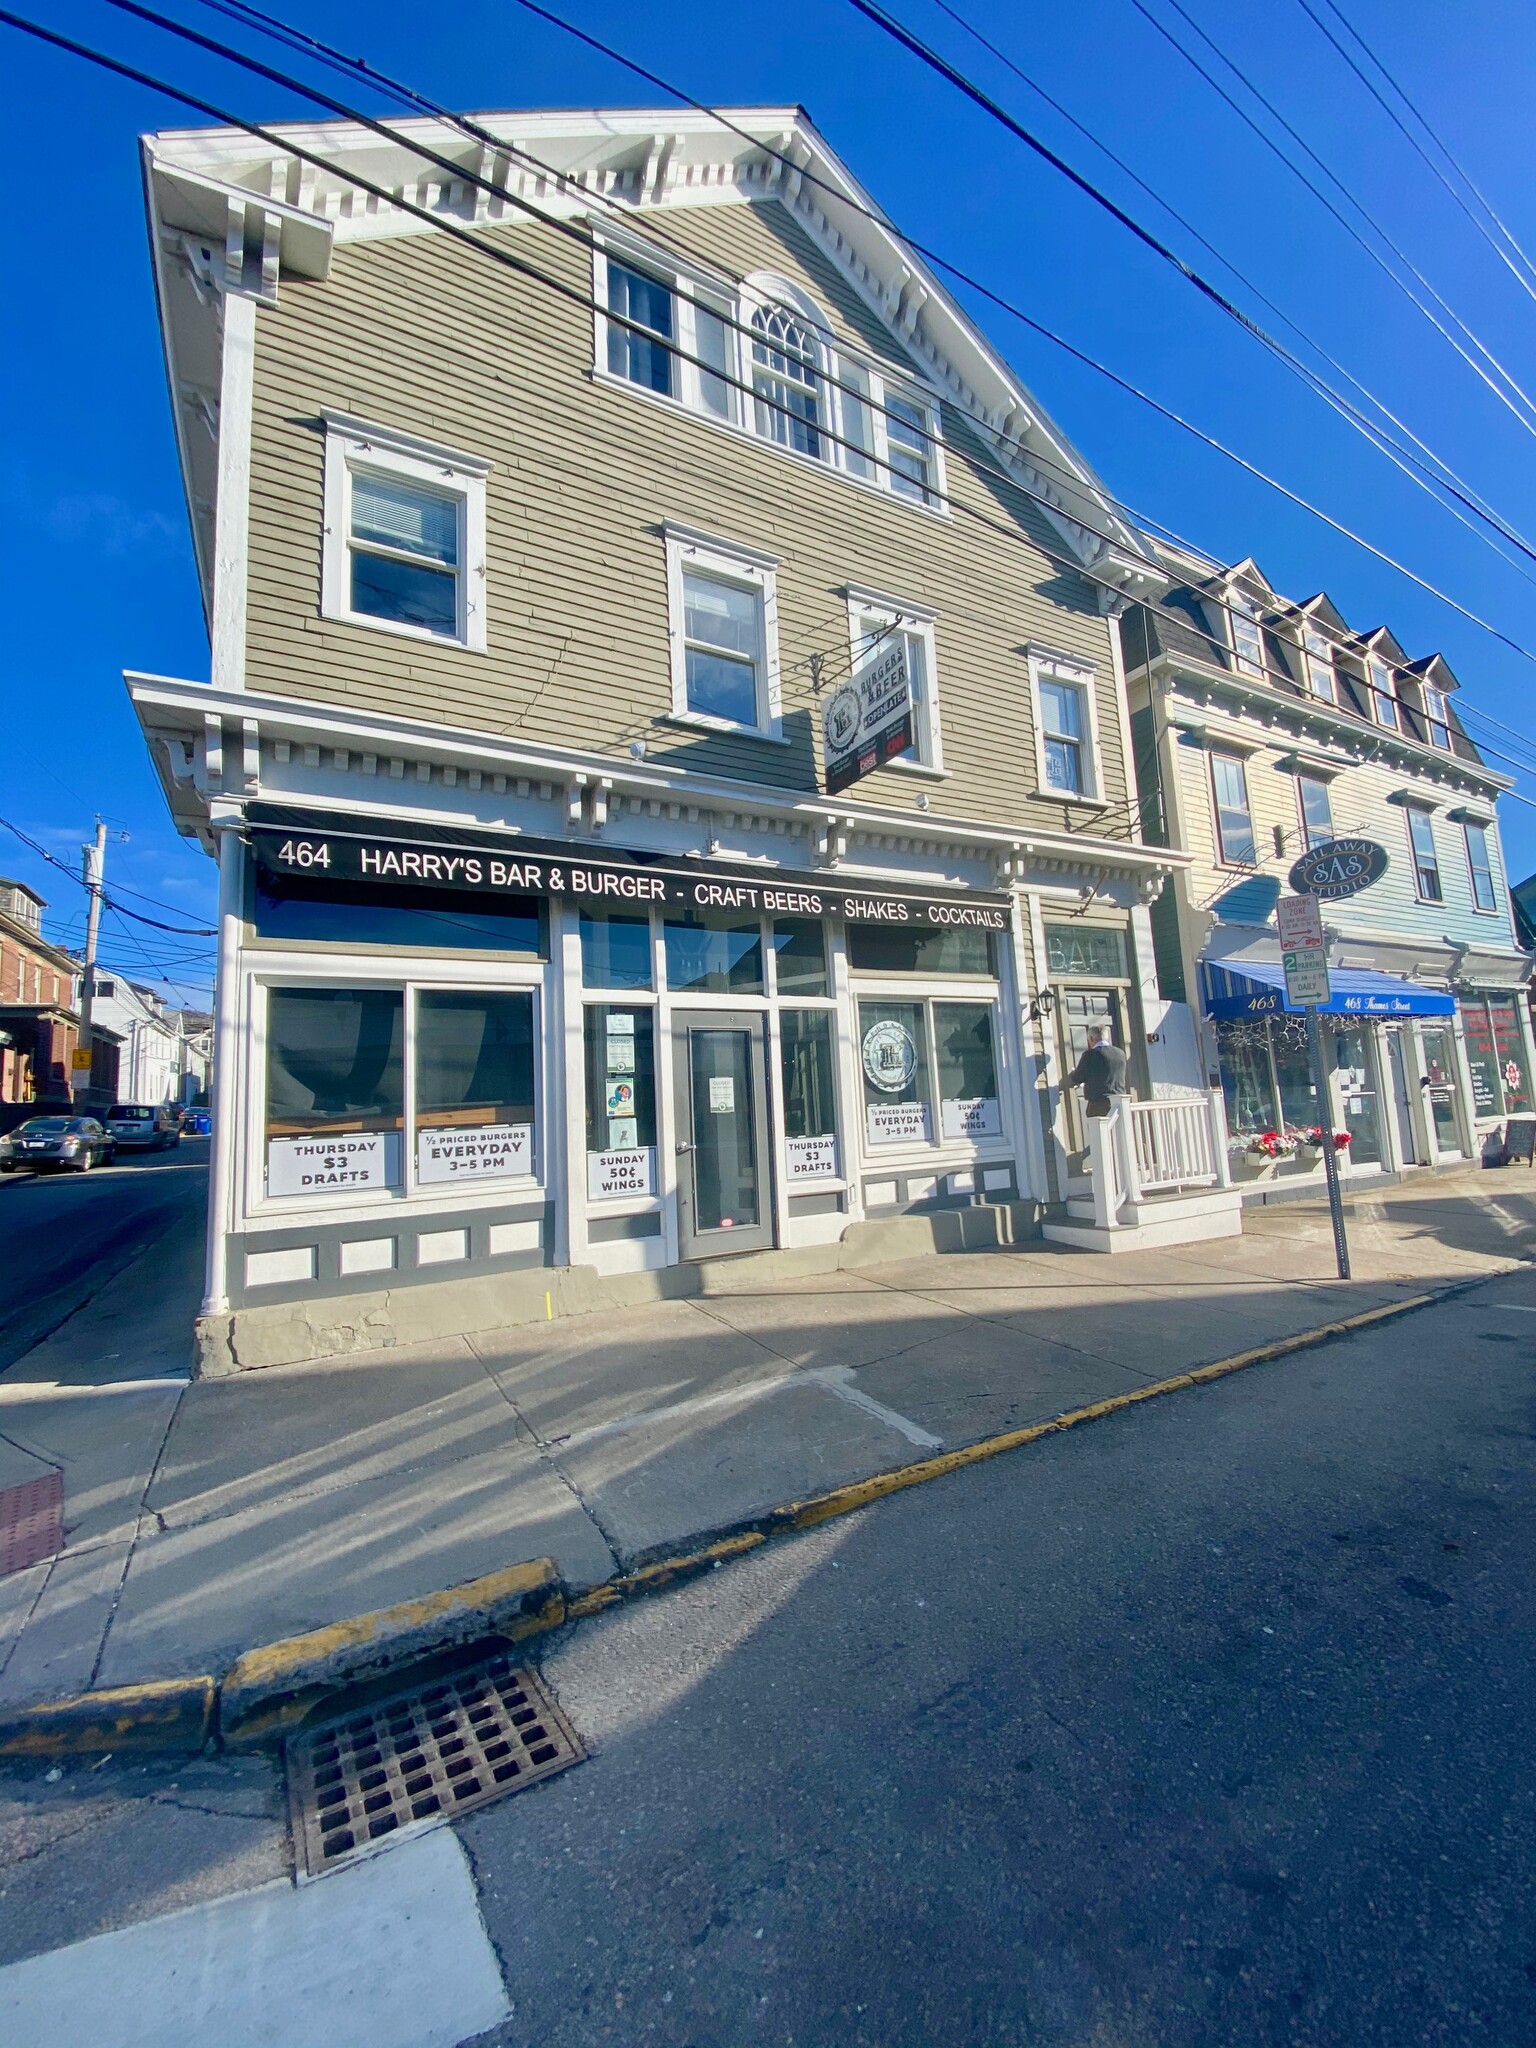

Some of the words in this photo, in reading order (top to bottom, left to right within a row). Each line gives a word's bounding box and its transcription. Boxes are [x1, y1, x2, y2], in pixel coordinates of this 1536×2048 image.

[860, 646, 903, 695] BURGERS
[867, 706, 885, 724] OPEN
[1296, 848, 1327, 873] SAIL
[1333, 841, 1379, 855] AWAY
[1313, 855, 1362, 883] SAS
[278, 840, 331, 868] 464
[361, 848, 483, 883] HARRY'S
[490, 861, 541, 888] BAR
[549, 867, 565, 891] &
[571, 870, 666, 900] BURGER
[694, 884, 758, 908] CRAFT
[763, 891, 821, 914] BEERS
[844, 898, 909, 921] SHAKES
[928, 906, 1004, 928] COCKTAILS
[1309, 875, 1370, 897] STUDIO
[1283, 897, 1311, 909] LOADING
[1289, 906, 1306, 916] ZONE
[1285, 957, 1296, 970] 2
[1298, 960, 1323, 969] PARKING
[1298, 983, 1316, 991] DAILY
[1248, 995, 1277, 1010] 468
[1345, 997, 1361, 1009] 468
[1364, 996, 1389, 1010] Thames
[1391, 997, 1411, 1010] Street
[878, 1108, 900, 1116] PRICED
[957, 1103, 985, 1111] SUNDAY
[875, 1115, 926, 1126] EVERYDAY
[964, 1112, 980, 1120] 50¢
[904, 1126, 917, 1135] PM
[960, 1121, 986, 1130] WINGS
[439, 1135, 476, 1144] PRICED
[480, 1132, 526, 1141] BURGERS
[294, 1141, 377, 1156] THURSDAY
[431, 1141, 522, 1159] EVERYDAY
[788, 1141, 835, 1151] THURSDAY
[600, 1155, 645, 1166] SUNDAY
[805, 1151, 819, 1161] $3
[323, 1156, 348, 1171] $3
[483, 1157, 505, 1168] PM
[794, 1162, 832, 1173] DRAFTS
[301, 1171, 369, 1185] DRAFTS
[610, 1166, 636, 1178] 50¢
[602, 1179, 644, 1191] WINGS
